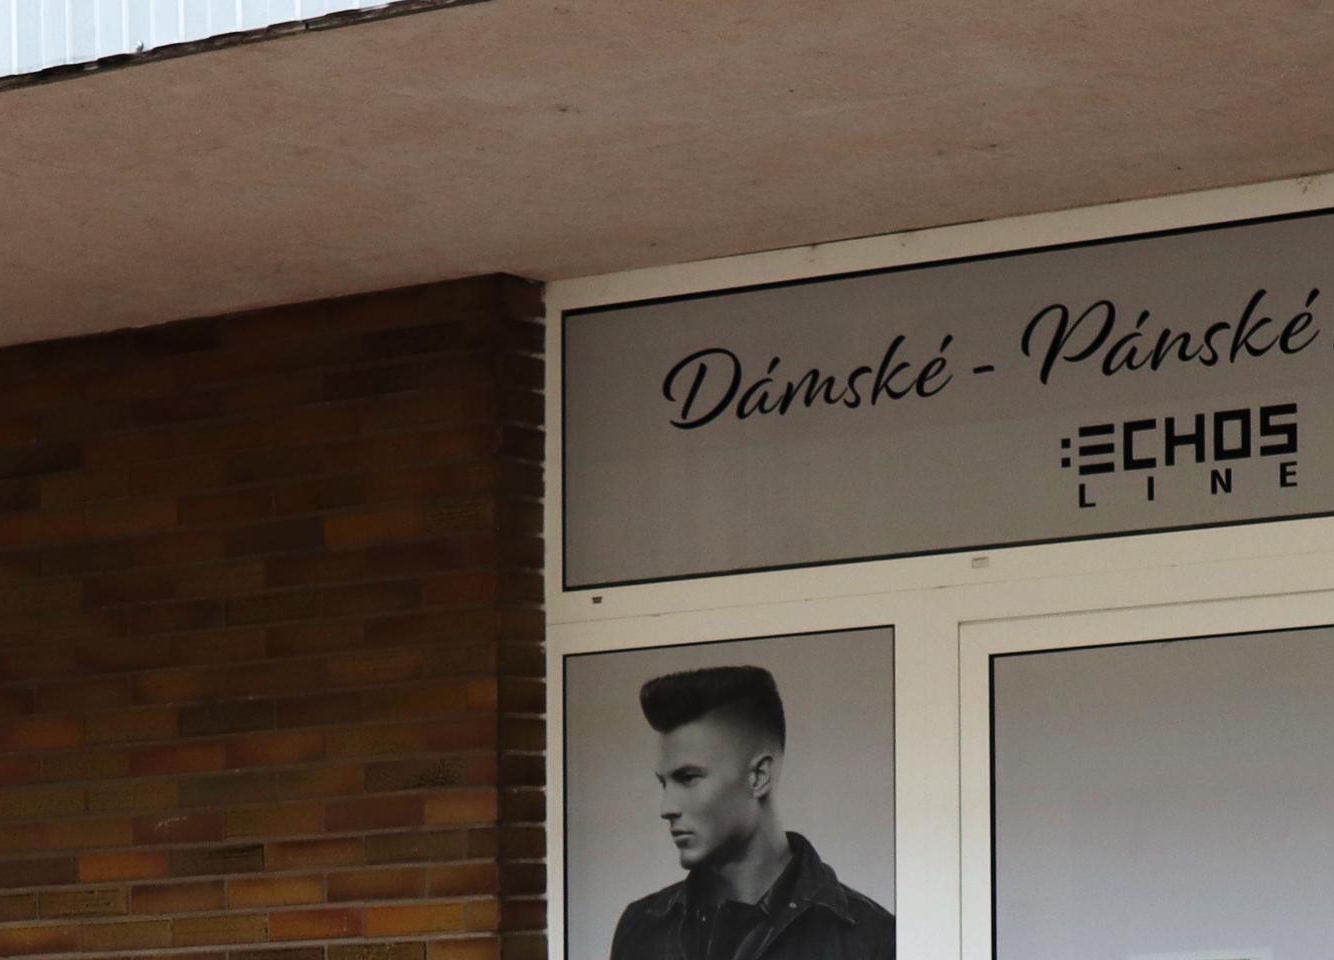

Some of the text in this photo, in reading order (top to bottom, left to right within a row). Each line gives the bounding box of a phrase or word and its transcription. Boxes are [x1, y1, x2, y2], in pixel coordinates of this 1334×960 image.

[661, 333, 955, 431] Dámské
[1020, 287, 1322, 386] Pánské
[1078, 460, 1298, 508] LINE
